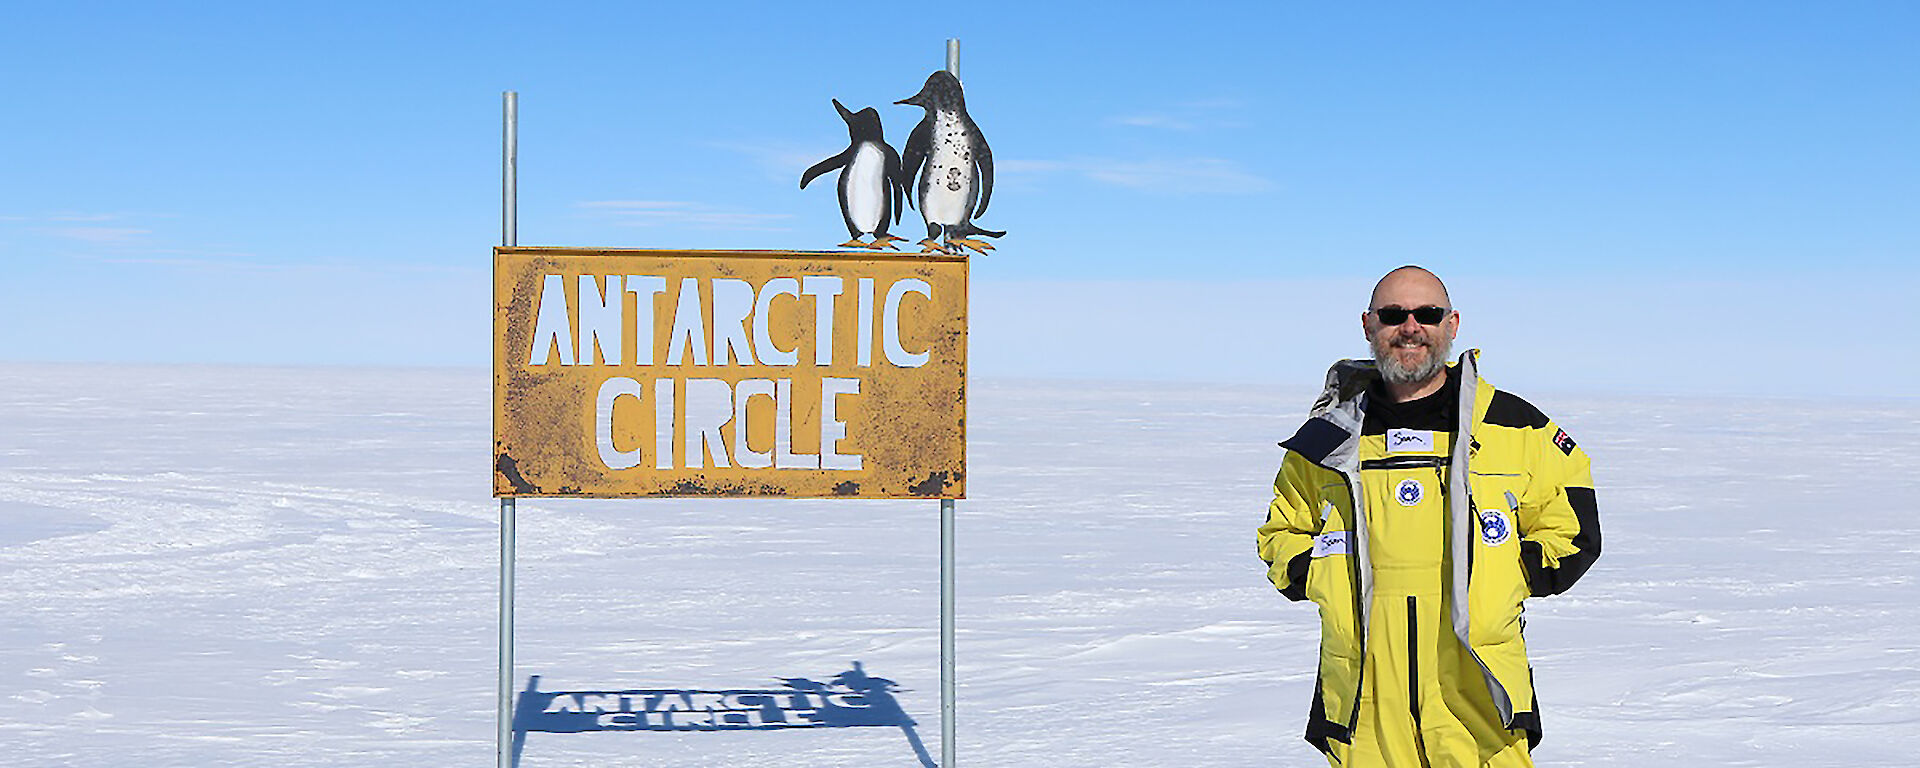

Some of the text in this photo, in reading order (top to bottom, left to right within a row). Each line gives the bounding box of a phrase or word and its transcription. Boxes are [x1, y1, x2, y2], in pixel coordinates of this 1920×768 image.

[529, 274, 932, 368] ANTARCTIC
[595, 377, 863, 470] CIRCLE
[543, 693, 871, 713] ANTARCTIC
